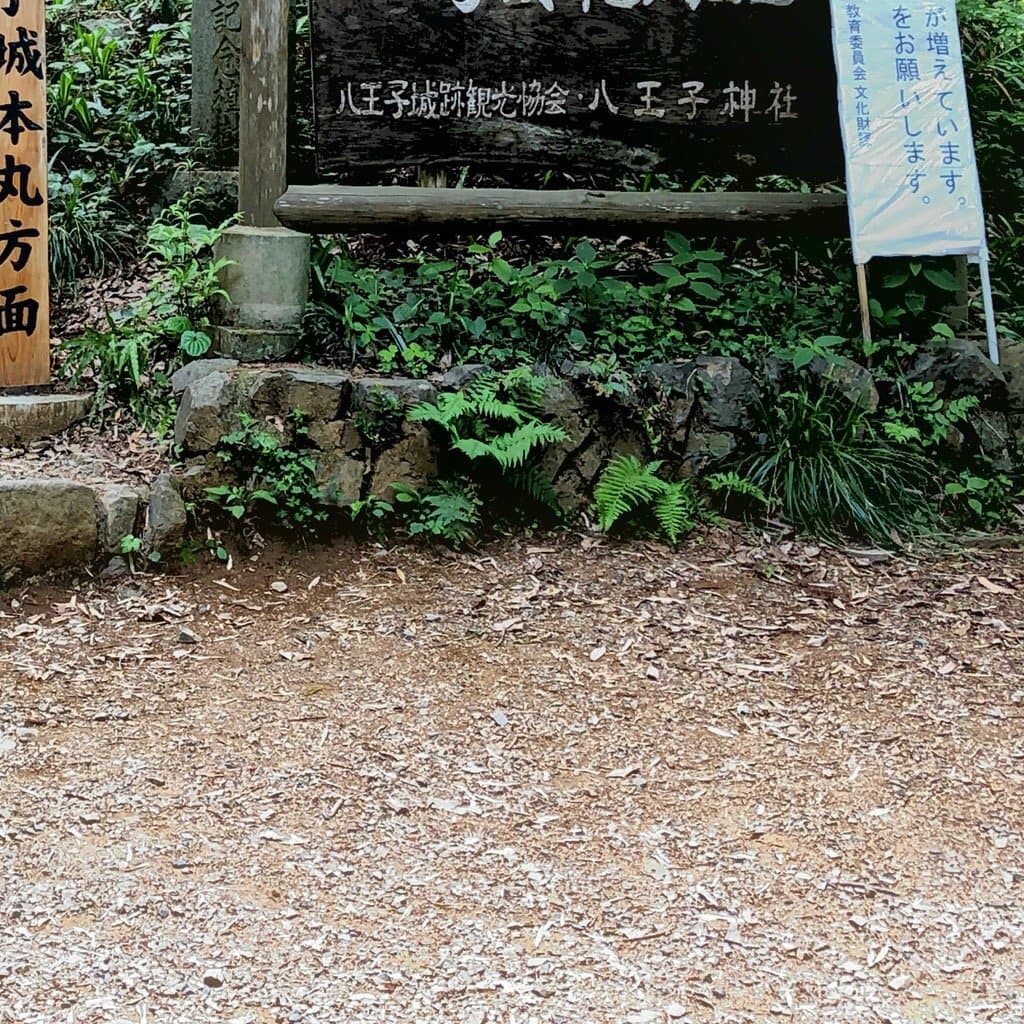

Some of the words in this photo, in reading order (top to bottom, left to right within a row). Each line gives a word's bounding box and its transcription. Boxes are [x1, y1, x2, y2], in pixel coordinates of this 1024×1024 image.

[846, 4, 866, 80] 教育委員会
